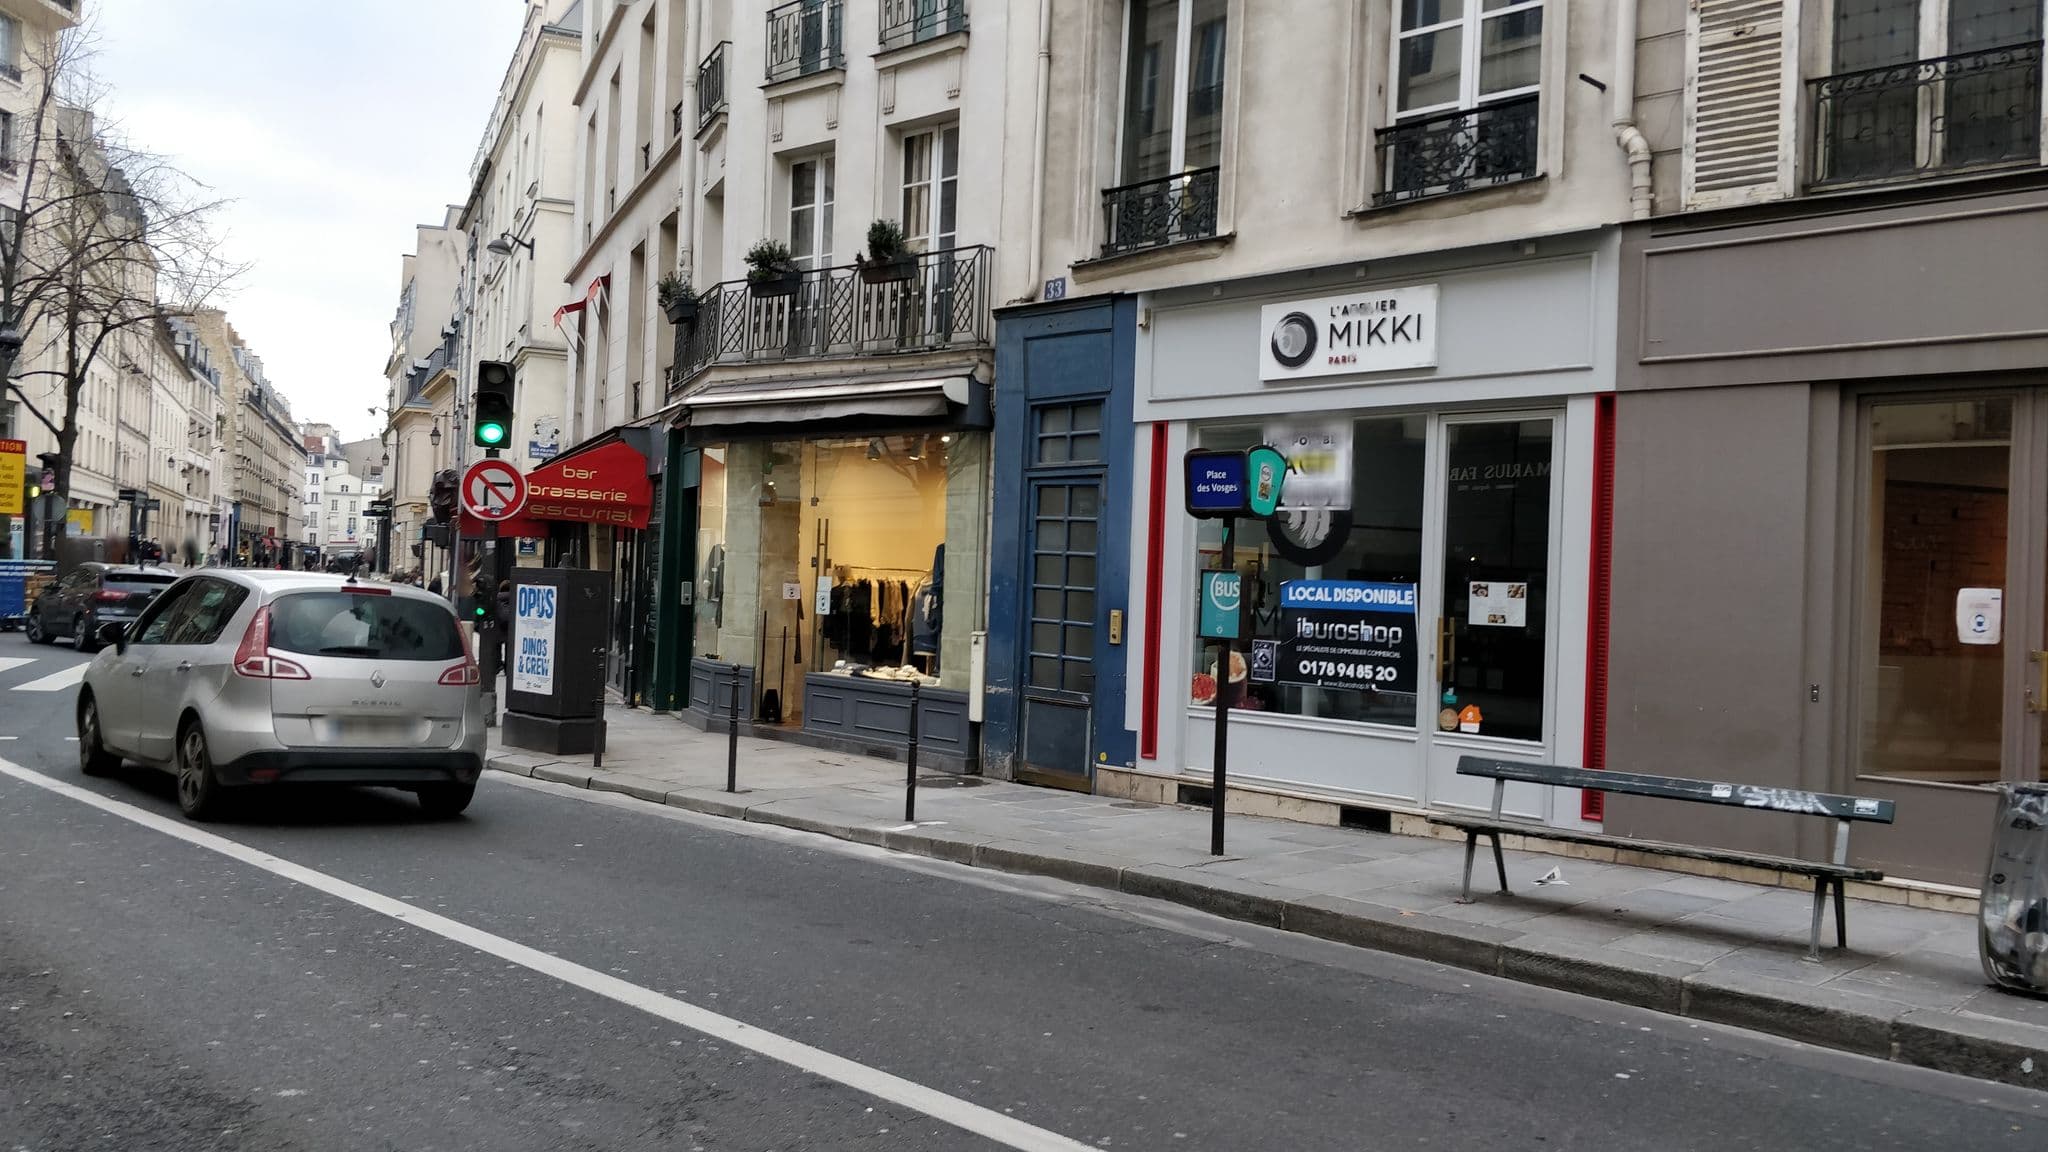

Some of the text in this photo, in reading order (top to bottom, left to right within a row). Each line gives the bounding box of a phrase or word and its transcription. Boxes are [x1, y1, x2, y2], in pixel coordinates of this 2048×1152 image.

[1047, 281, 1063, 299] 33
[1330, 299, 1397, 318] L'AIER
[1328, 313, 1422, 349] MIKKI
[1328, 355, 1358, 365] PARIS
[562, 464, 598, 479] bar
[1206, 470, 1227, 480] Place
[528, 481, 628, 502] brasserie
[1197, 483, 1238, 494] des Vosges
[530, 503, 633, 523] escurial
[1215, 580, 1241, 598] BUS
[1288, 586, 1414, 605] LOCAL DISPONIBLE
[518, 587, 554, 619] OPUS
[1296, 617, 1403, 648] iburoshop
[522, 637, 548, 657] DINOS
[518, 655, 550, 676] & CREW
